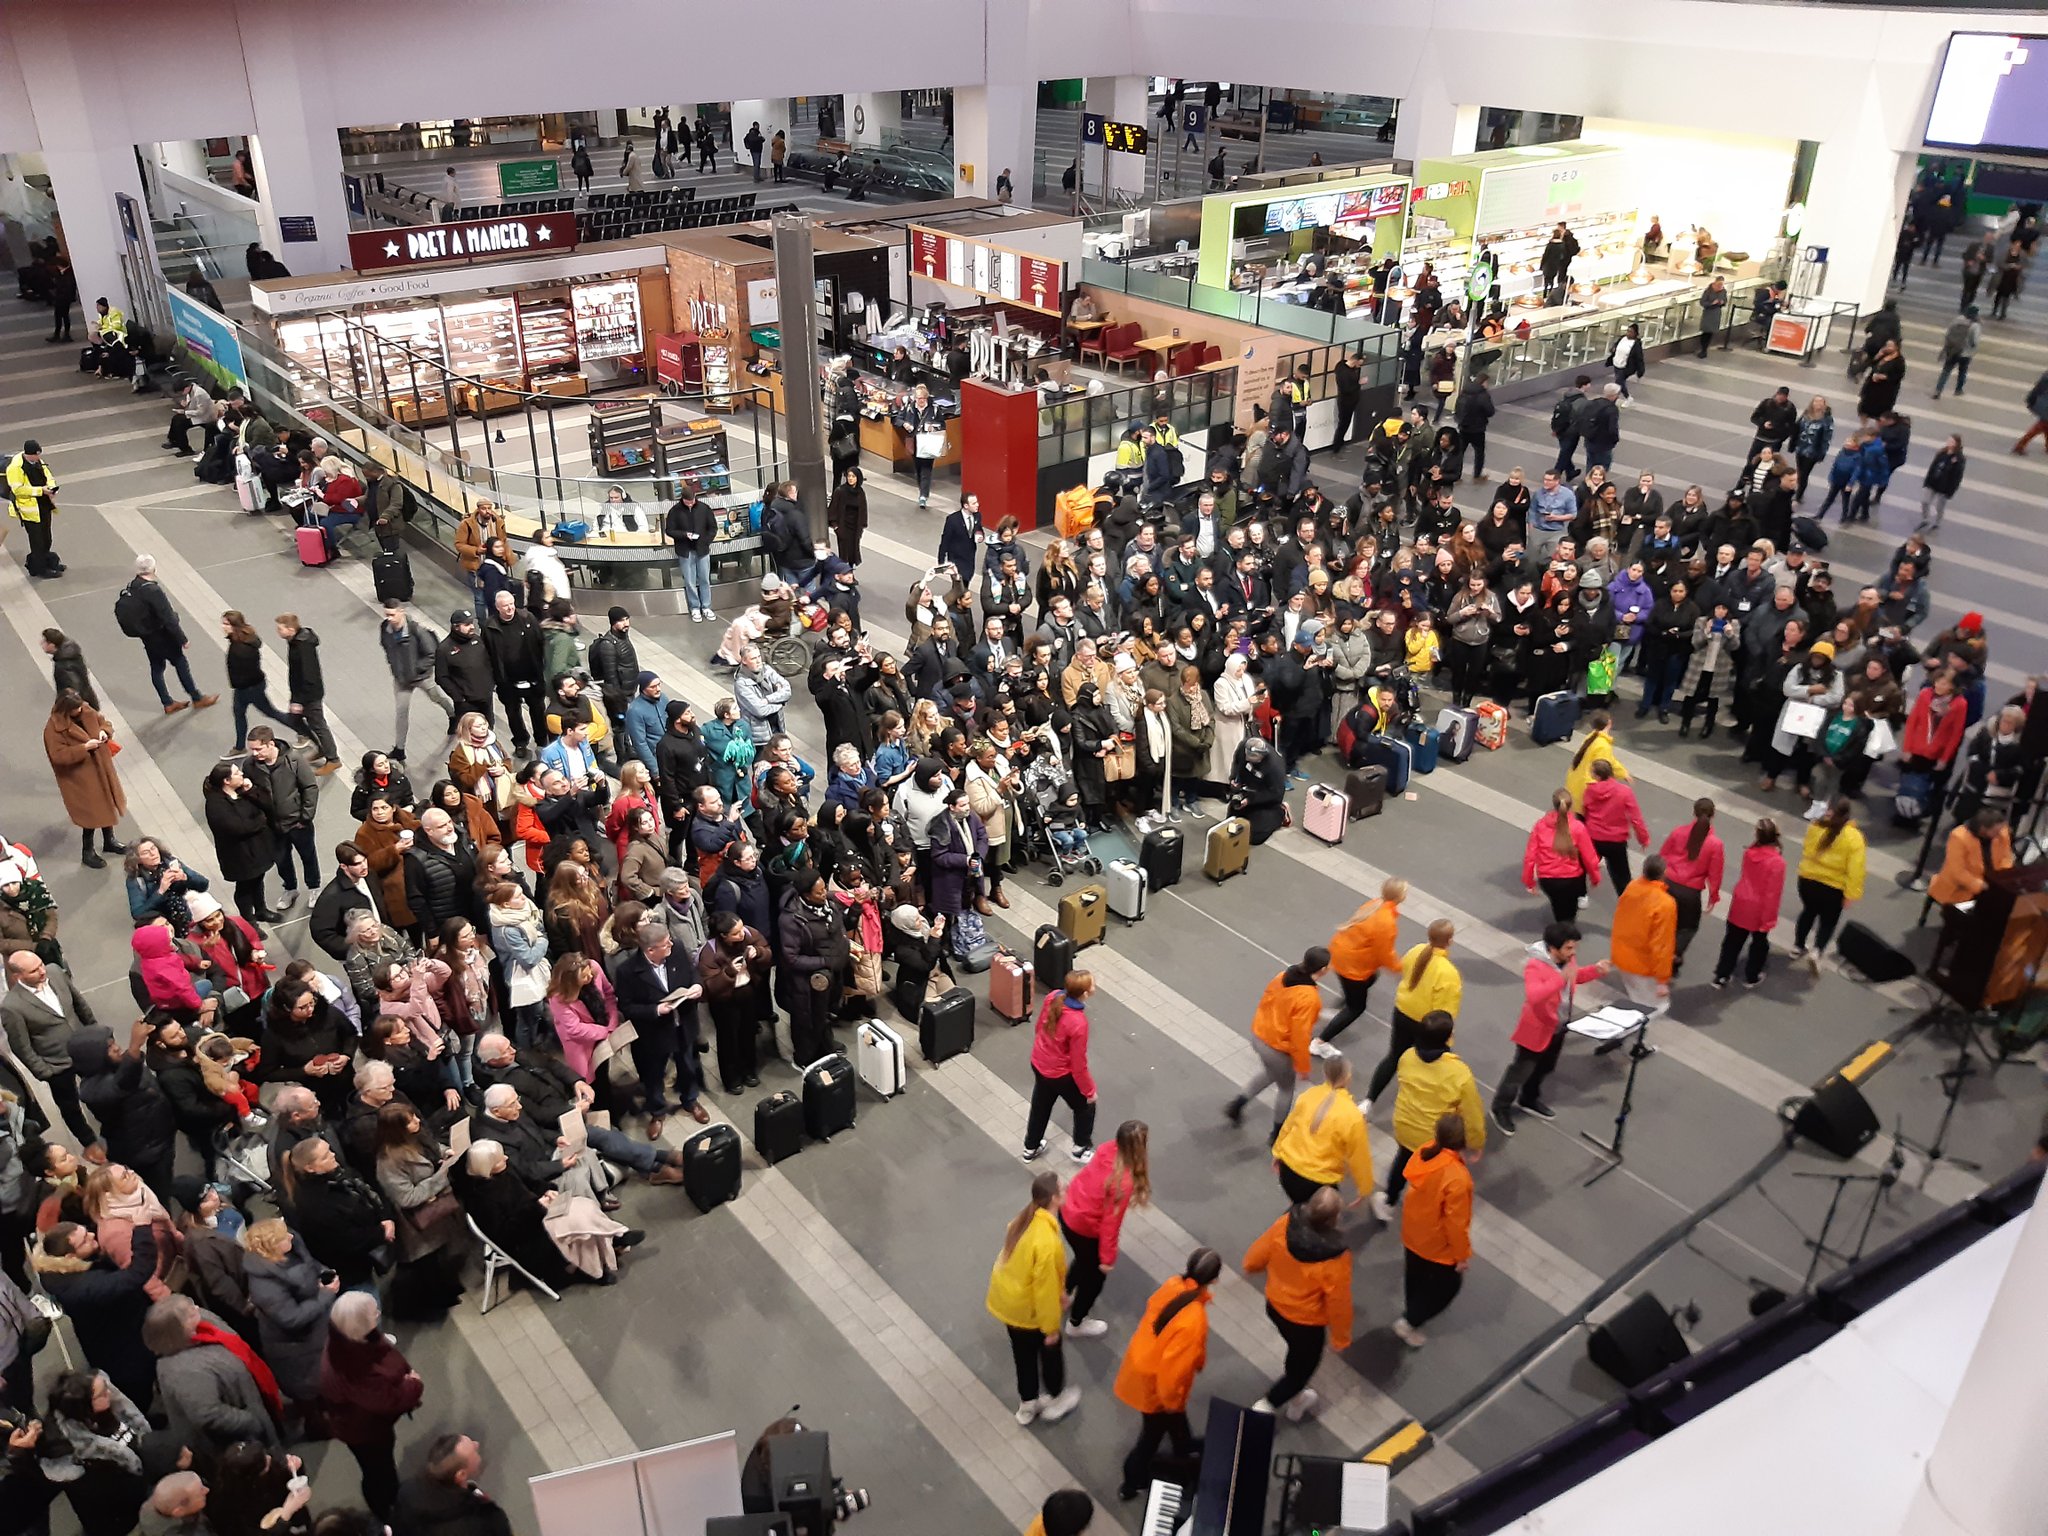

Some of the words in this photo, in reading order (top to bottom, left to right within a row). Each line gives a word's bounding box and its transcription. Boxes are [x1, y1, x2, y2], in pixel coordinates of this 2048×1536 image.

[853, 104, 865, 135] 9
[1087, 120, 1095, 135] 8
[1189, 111, 1197, 126] 9
[348, 184, 355, 204] 7
[407, 229, 447, 259] PRET
[452, 229, 463, 255] A
[466, 222, 529, 253] MANGER
[295, 291, 332, 306] Organic
[338, 285, 366, 300] Coffee
[378, 281, 405, 294] Good
[407, 278, 429, 290] Food
[970, 330, 1010, 382] PRET
